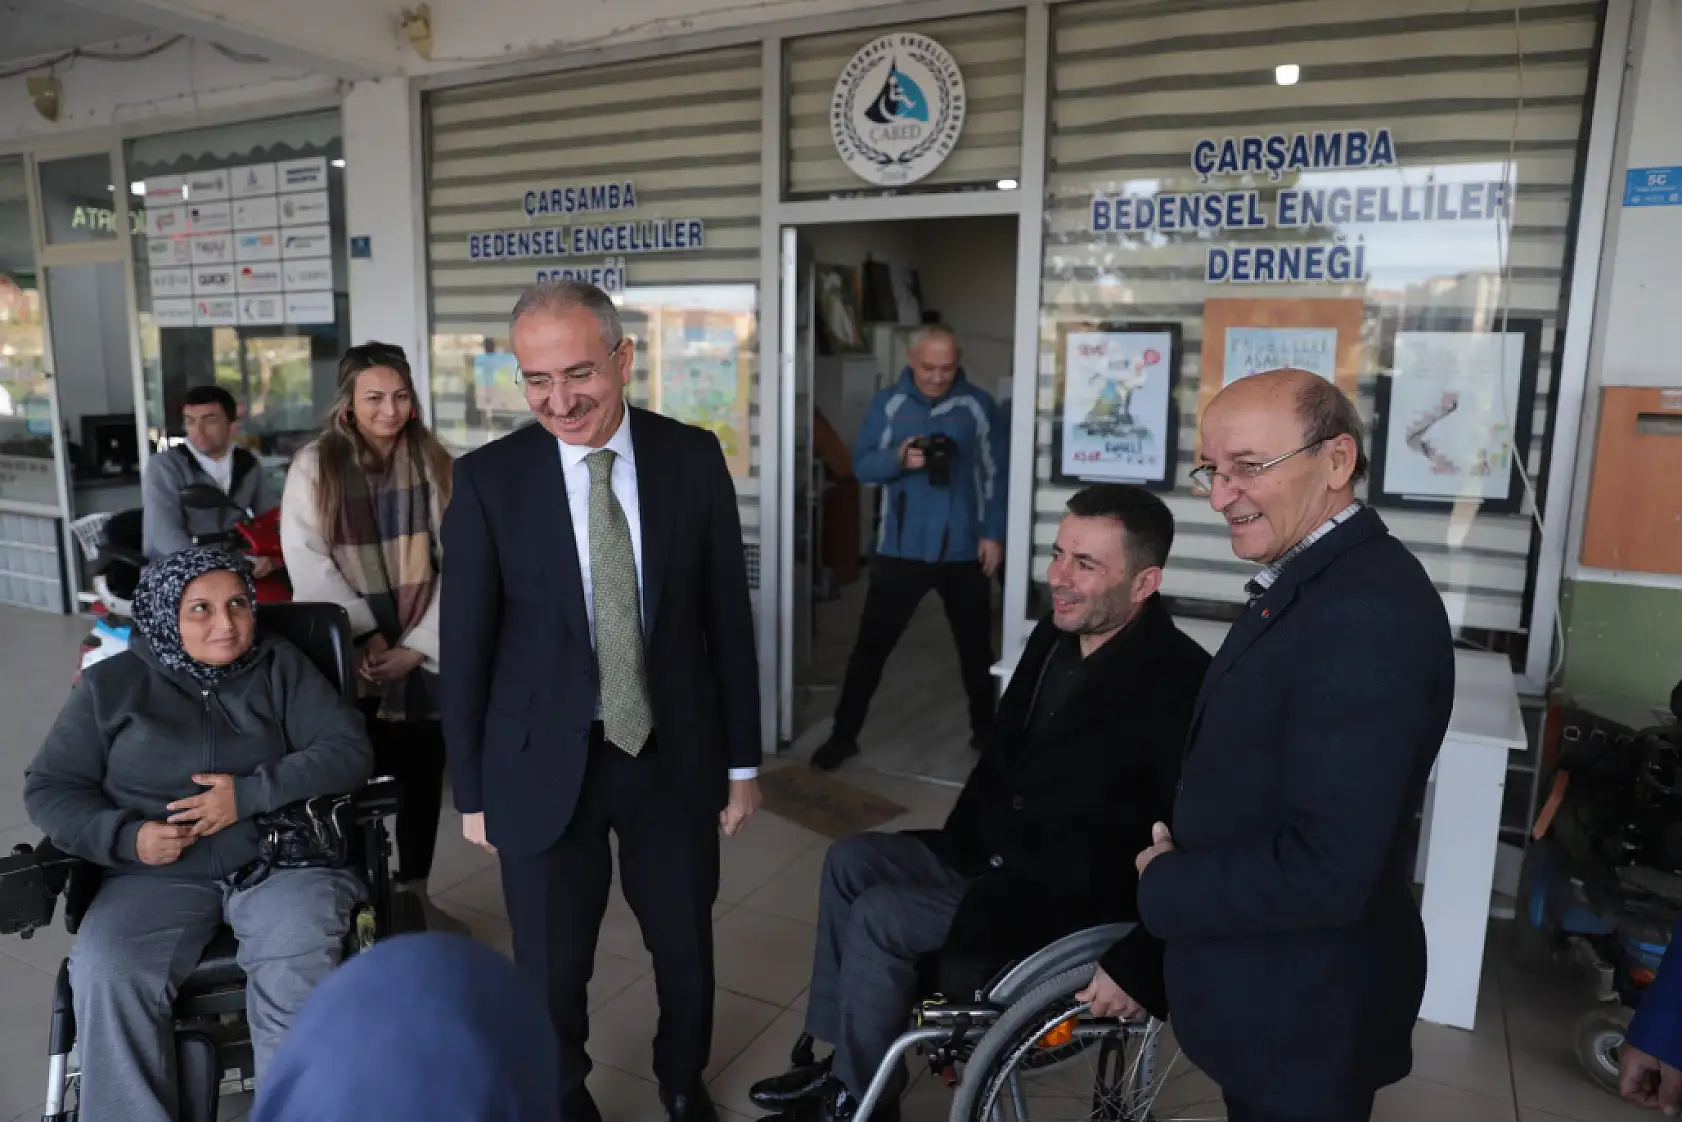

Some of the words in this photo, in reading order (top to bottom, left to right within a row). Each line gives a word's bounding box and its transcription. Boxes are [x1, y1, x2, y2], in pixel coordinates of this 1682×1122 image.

[1193, 127, 1396, 184] ÇARŞAMBA
[524, 181, 636, 222] ÇARŞAMBA
[1091, 191, 1266, 232] BEDENSEL
[1275, 173, 1511, 227] ENGELLİLER
[469, 227, 567, 260] BEDENSEL
[571, 216, 703, 254] ENGELLİLER
[1206, 234, 1366, 283] DERNEĞİ
